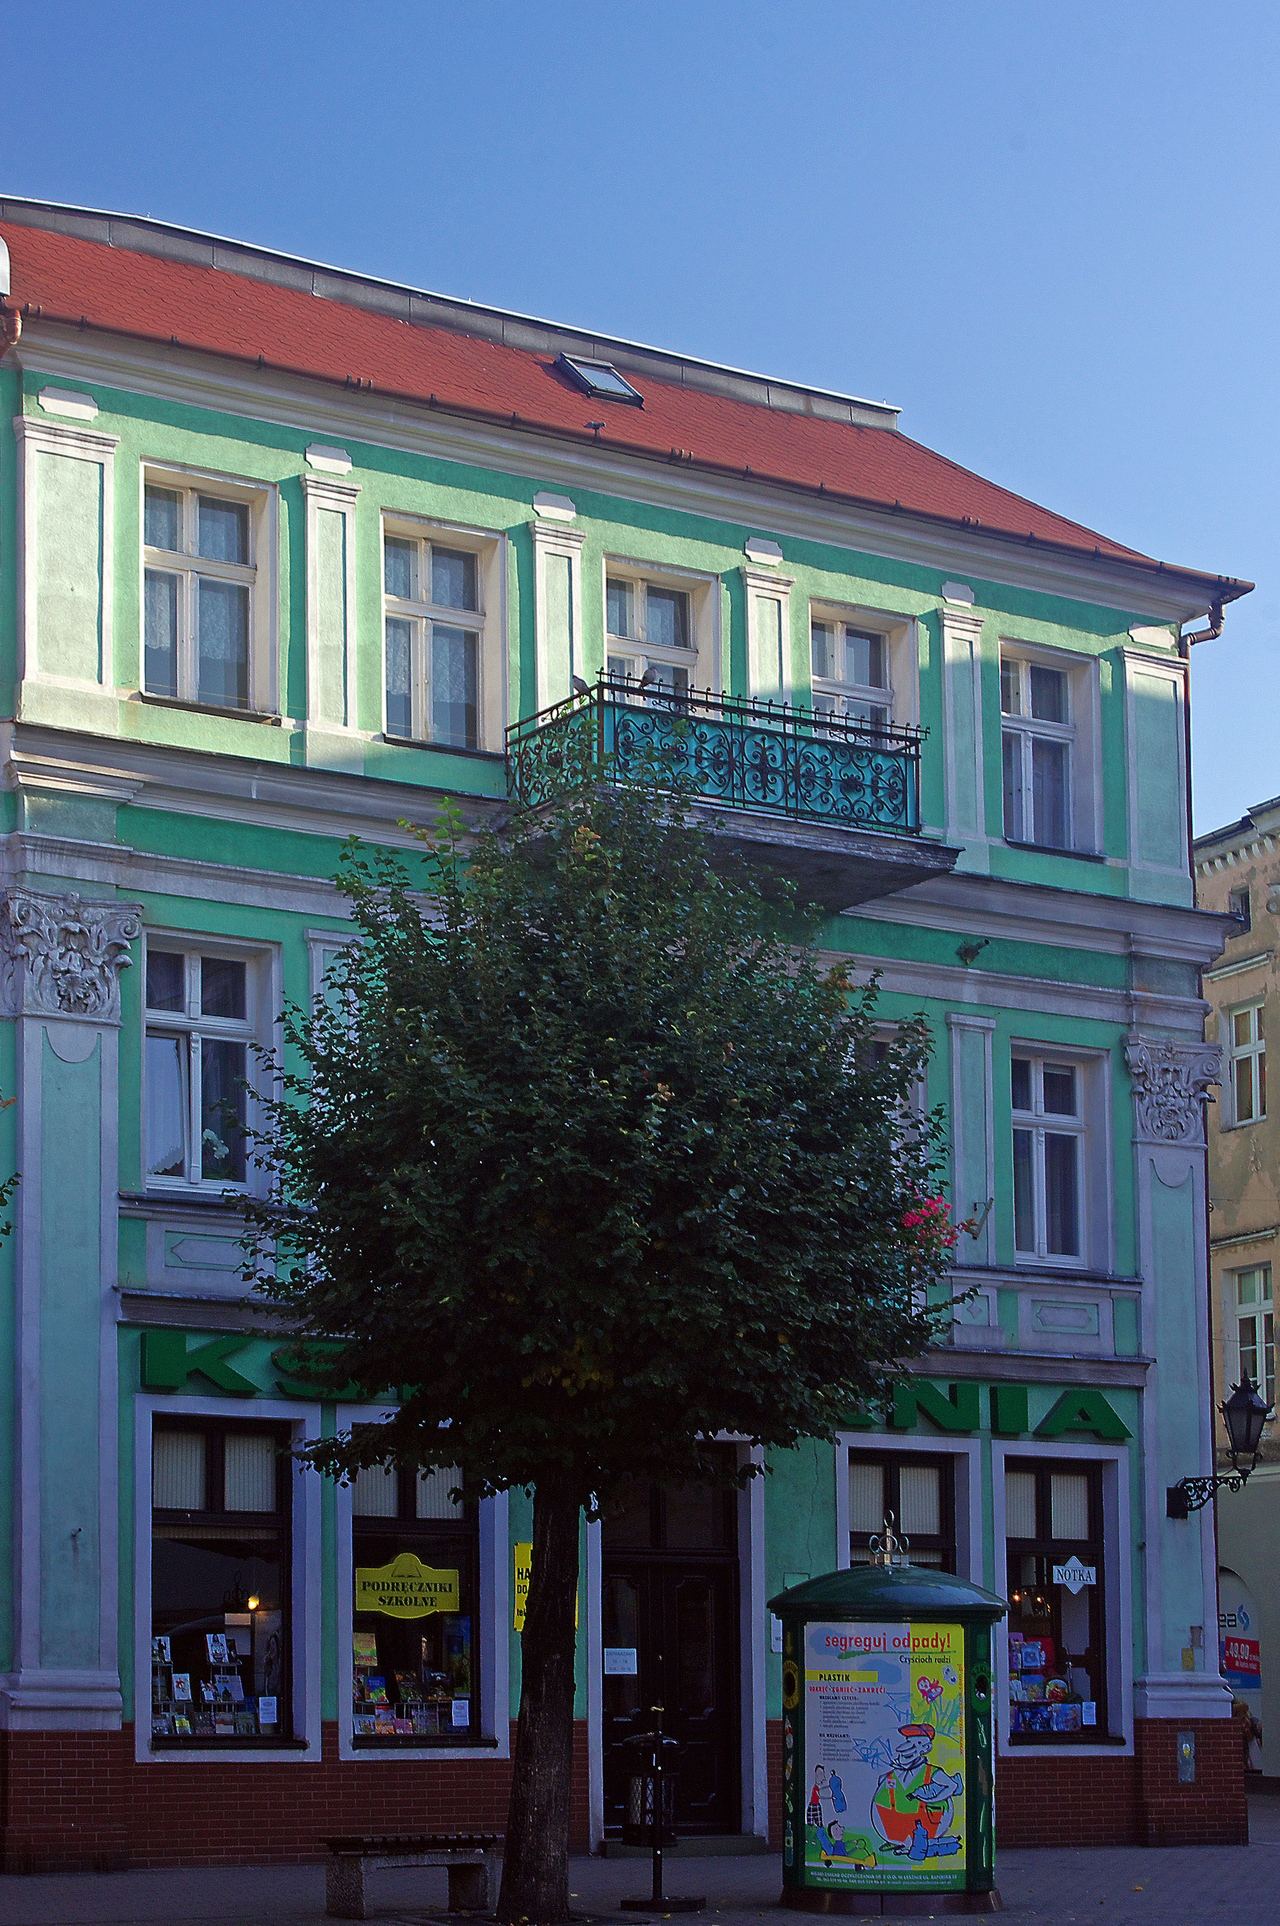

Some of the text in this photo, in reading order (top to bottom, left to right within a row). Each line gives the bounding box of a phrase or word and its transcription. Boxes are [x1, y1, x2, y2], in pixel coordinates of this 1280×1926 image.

[1056, 1568, 1093, 1582] NOTKA
[362, 1581, 452, 1594] PODRĘCZNIKI
[378, 1596, 437, 1607] SZKOLNE
[825, 1632, 951, 1653] segreguj odpady!
[899, 1655, 951, 1664] Czyścioch radzi
[818, 1673, 850, 1682] PLASTIK
